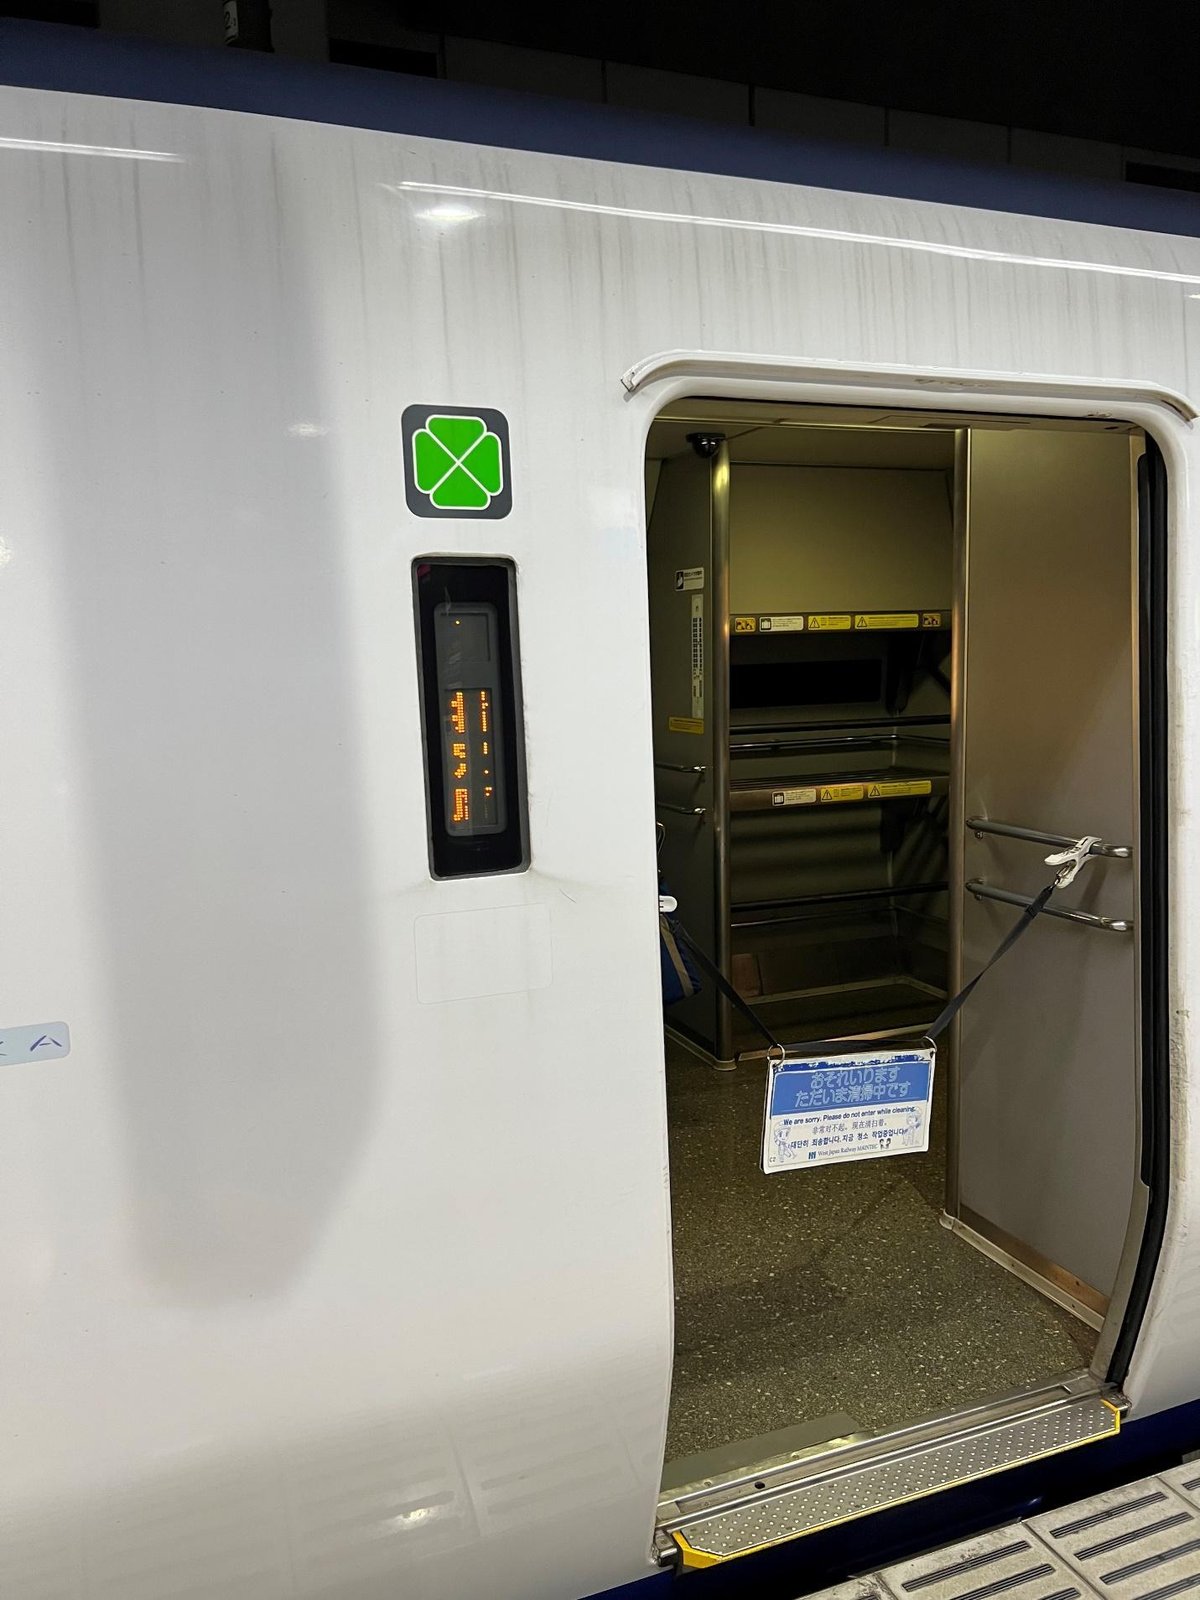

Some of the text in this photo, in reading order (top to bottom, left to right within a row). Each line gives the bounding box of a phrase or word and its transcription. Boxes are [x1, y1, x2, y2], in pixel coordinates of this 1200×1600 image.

[810, 1067, 901, 1088] おそれいります
[794, 1081, 911, 1108] ただいま清掃中です
[805, 1117, 822, 1125] sorry.
[861, 1109, 876, 1117] enter
[877, 1107, 891, 1115] while
[892, 1105, 916, 1114] cleaning.
[790, 1139, 809, 1149] 대단히
[842, 1133, 854, 1142] 지금
